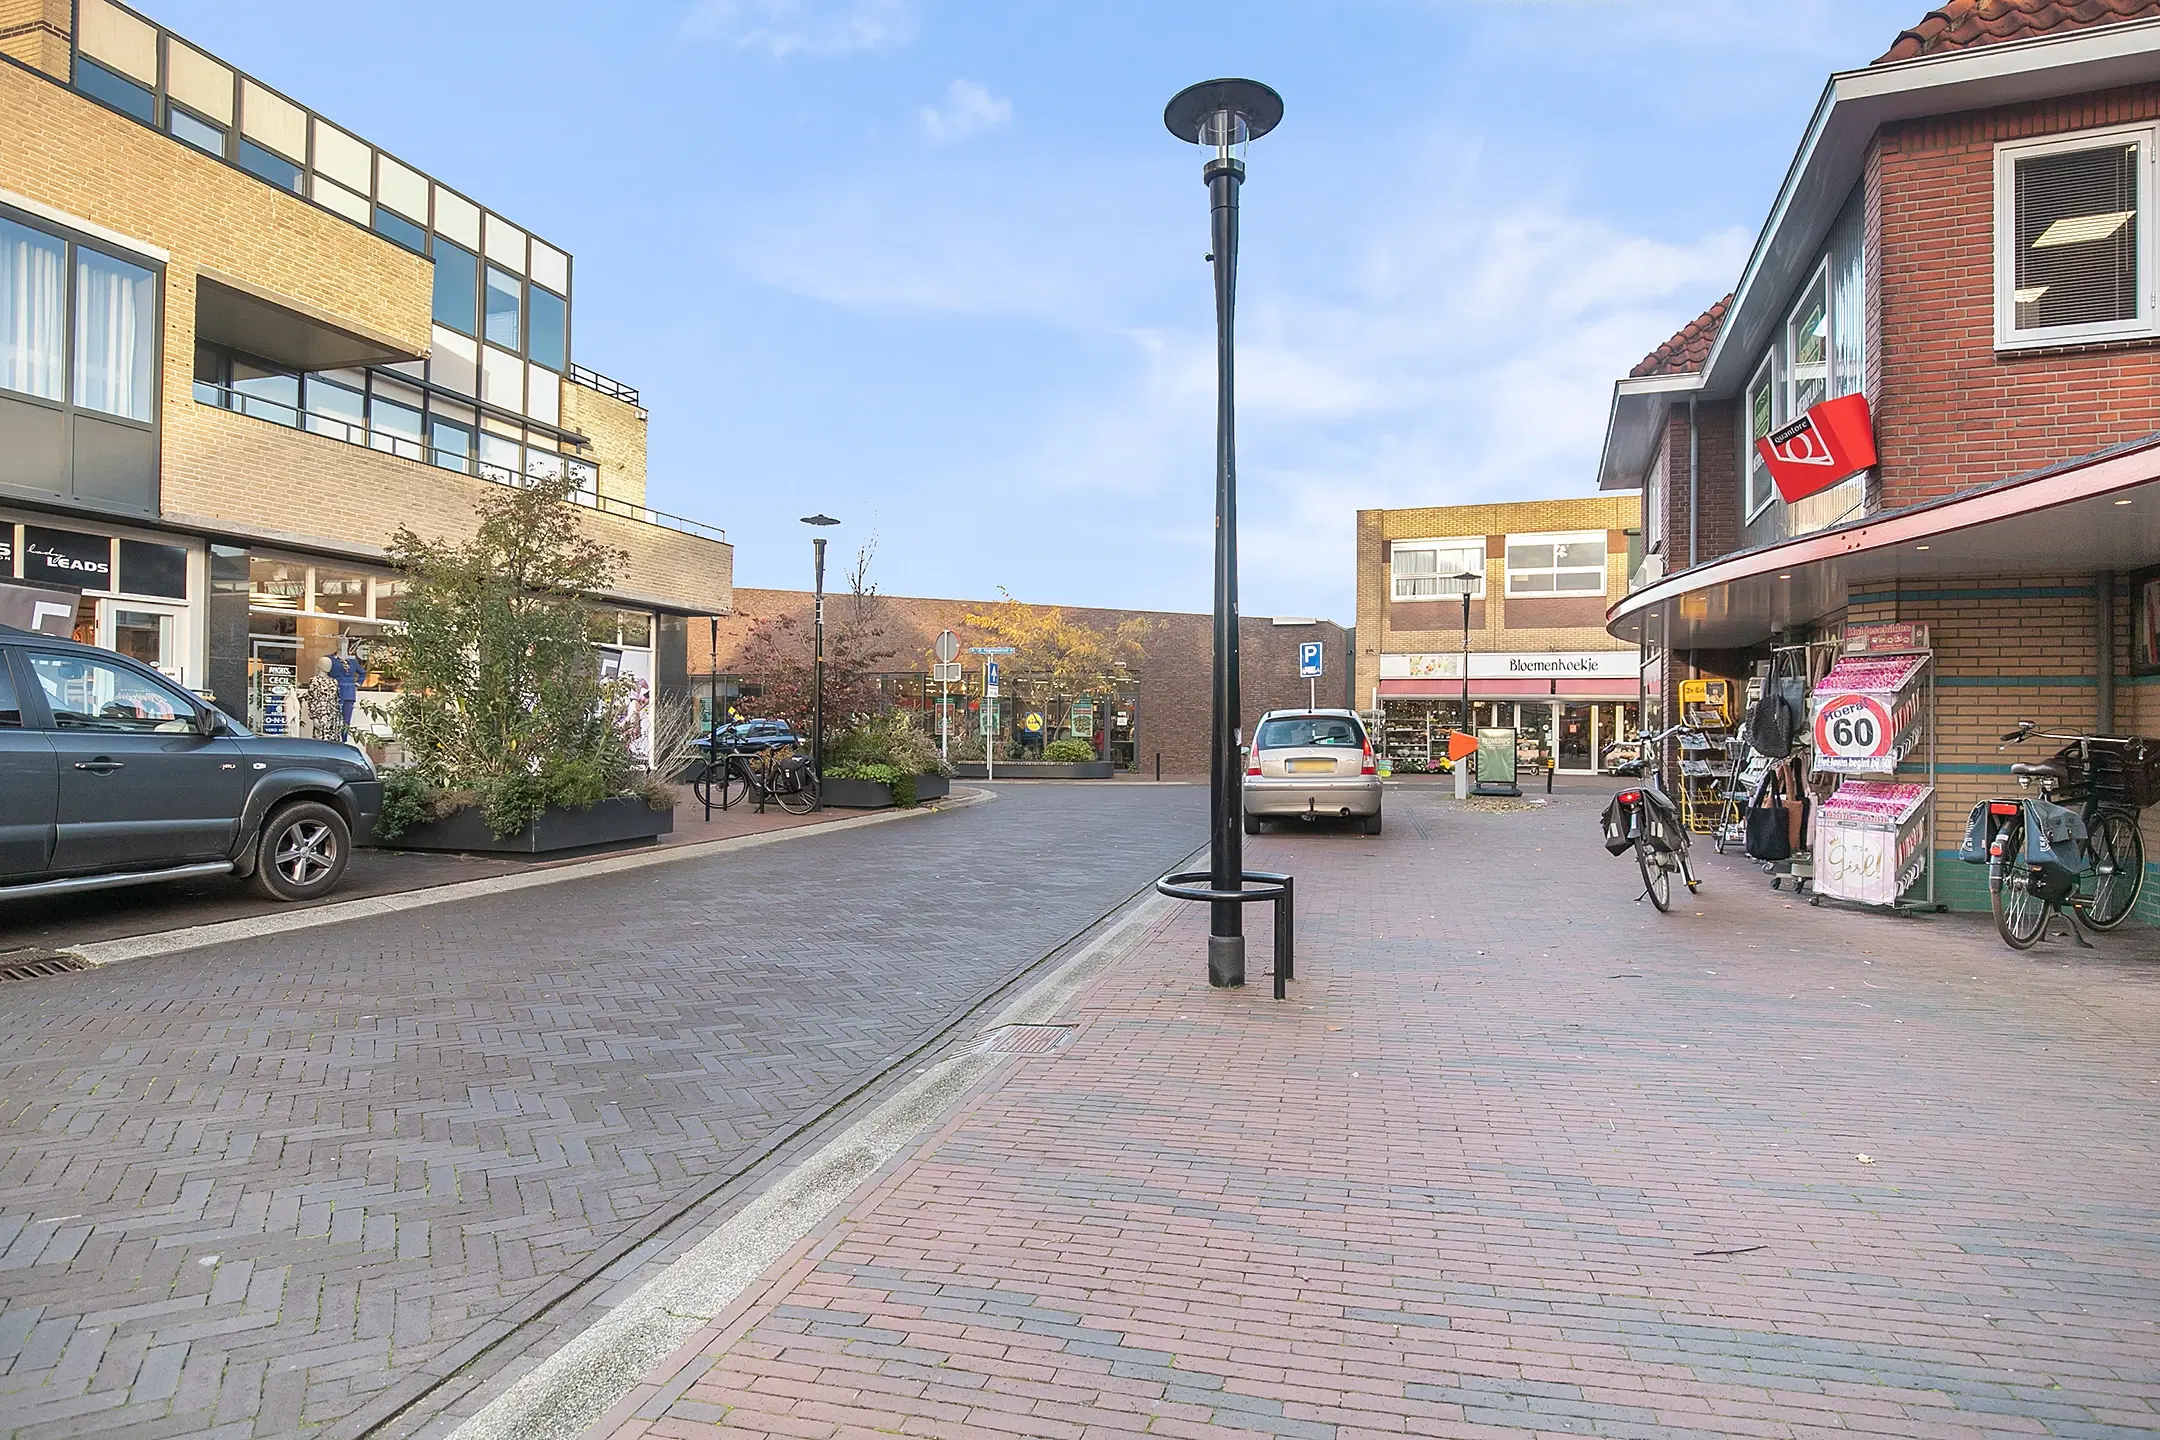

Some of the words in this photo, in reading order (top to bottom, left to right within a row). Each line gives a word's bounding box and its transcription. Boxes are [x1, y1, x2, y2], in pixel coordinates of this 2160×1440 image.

[46, 556, 109, 573] LEADS
[1305, 645, 1317, 663] P
[1509, 658, 1598, 672] Bloemenhoekje
[269, 676, 290, 684] CECIL
[1822, 697, 1869, 722] Hoera!
[1833, 718, 1874, 747] 60
